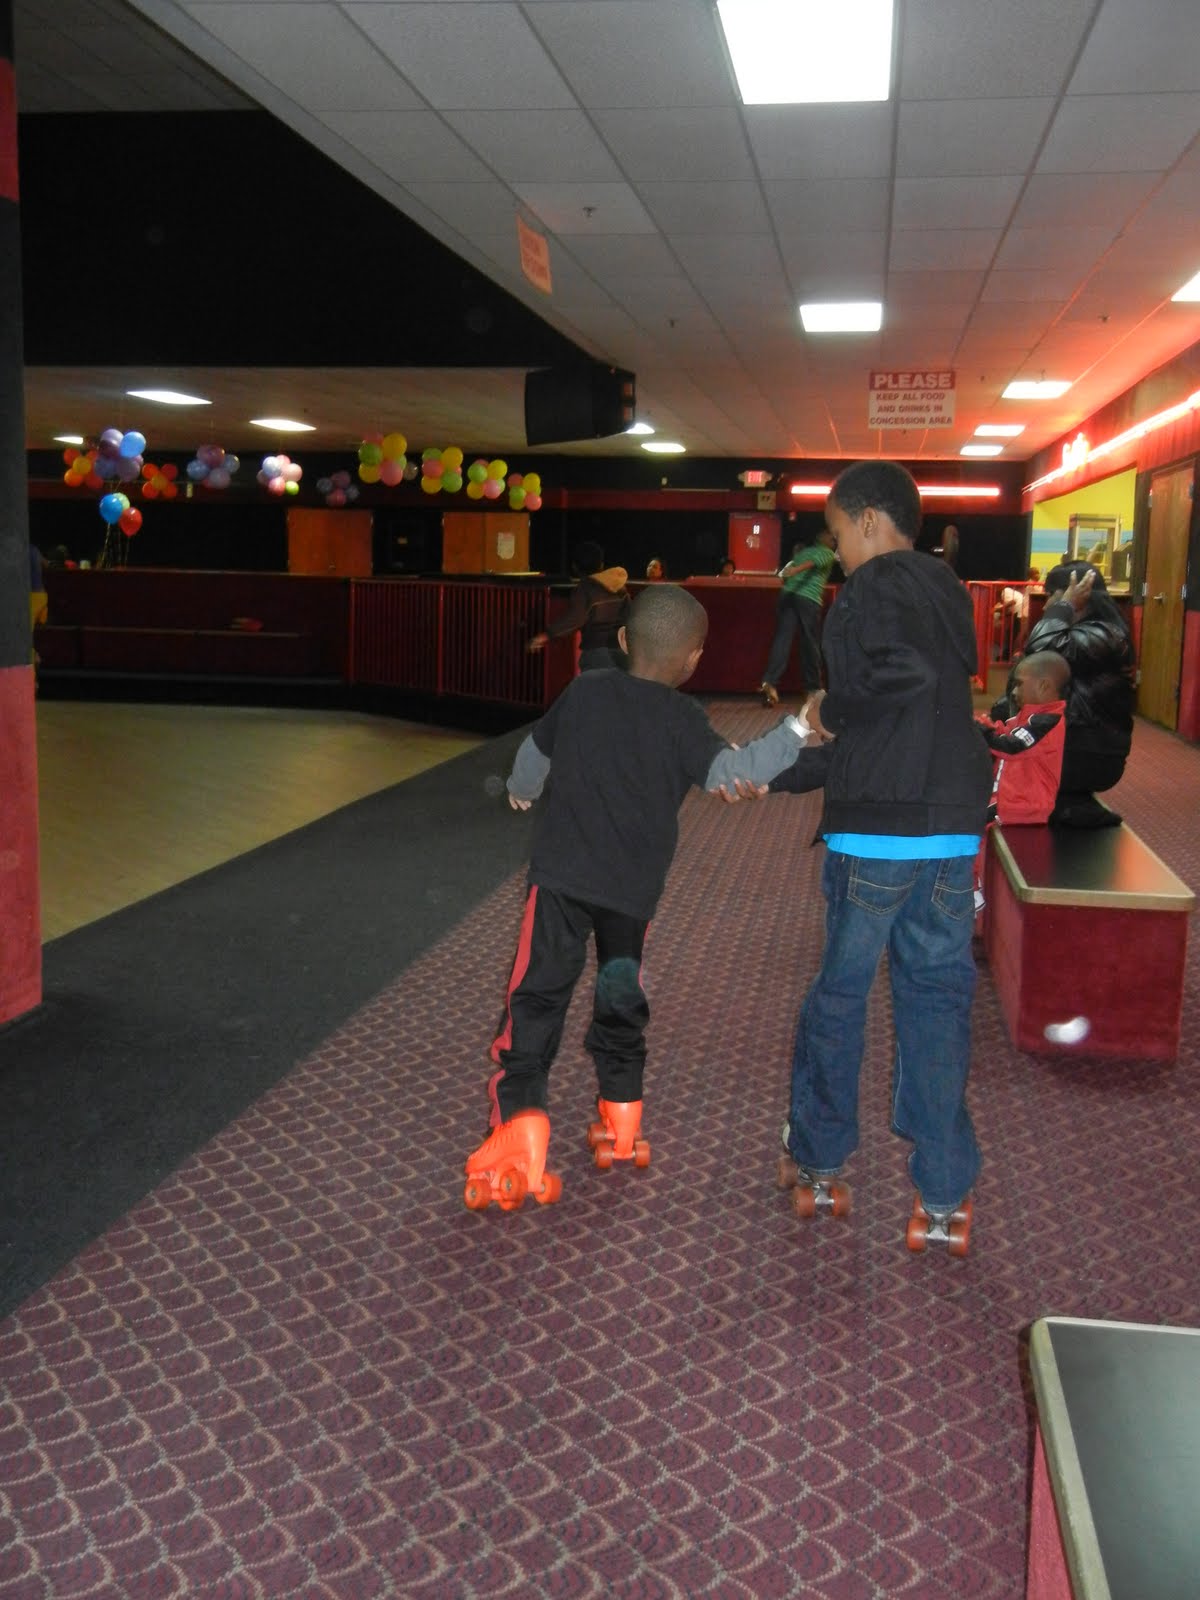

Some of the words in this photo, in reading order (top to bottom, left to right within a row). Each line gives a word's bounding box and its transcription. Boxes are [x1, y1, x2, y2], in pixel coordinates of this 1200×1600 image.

[874, 373, 952, 389] PLEASE
[876, 392, 899, 401] KEEP
[902, 392, 918, 401] ALL
[921, 392, 945, 401] FOOD
[877, 405, 896, 413] AND
[899, 405, 931, 413] DRINKS
[934, 405, 943, 413] IN
[870, 417, 926, 425] CONCESSION
[928, 417, 953, 425] AREA
